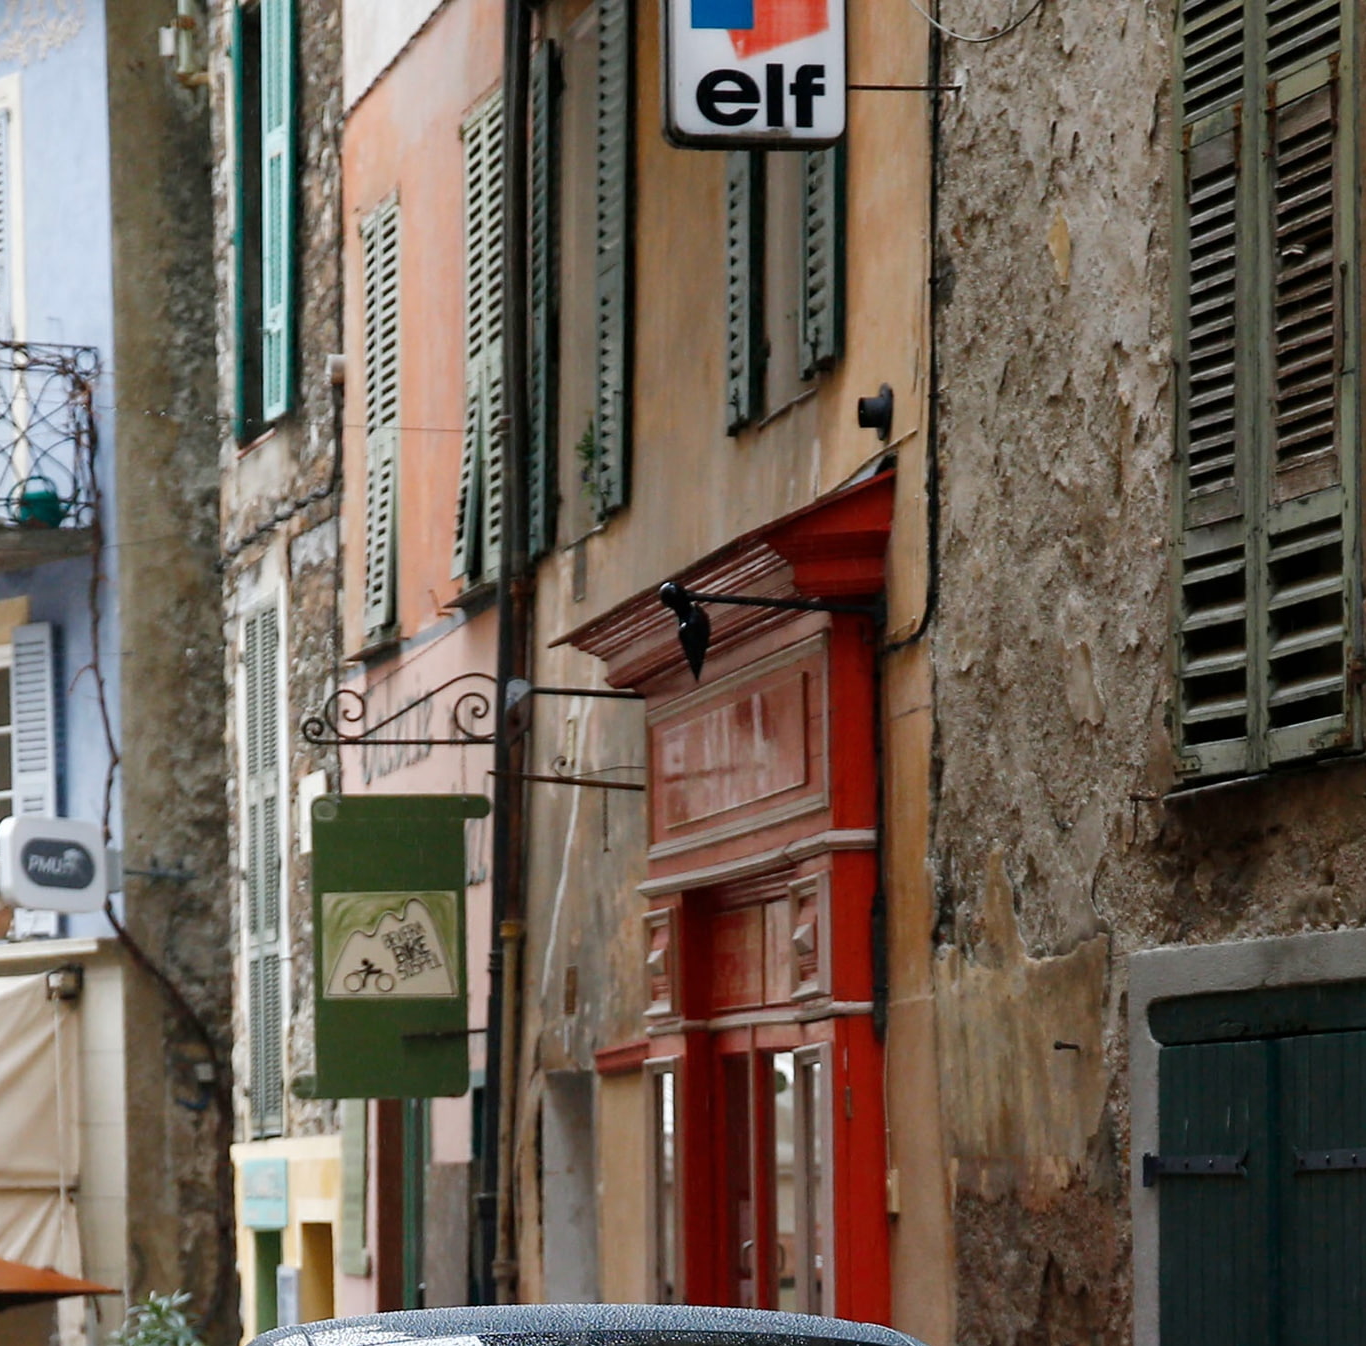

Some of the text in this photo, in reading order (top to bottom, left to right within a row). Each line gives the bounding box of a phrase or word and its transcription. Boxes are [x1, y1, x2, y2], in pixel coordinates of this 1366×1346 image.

[696, 64, 825, 128] elf
[28, 853, 63, 874] PMU
[392, 935, 430, 964] BIKE
